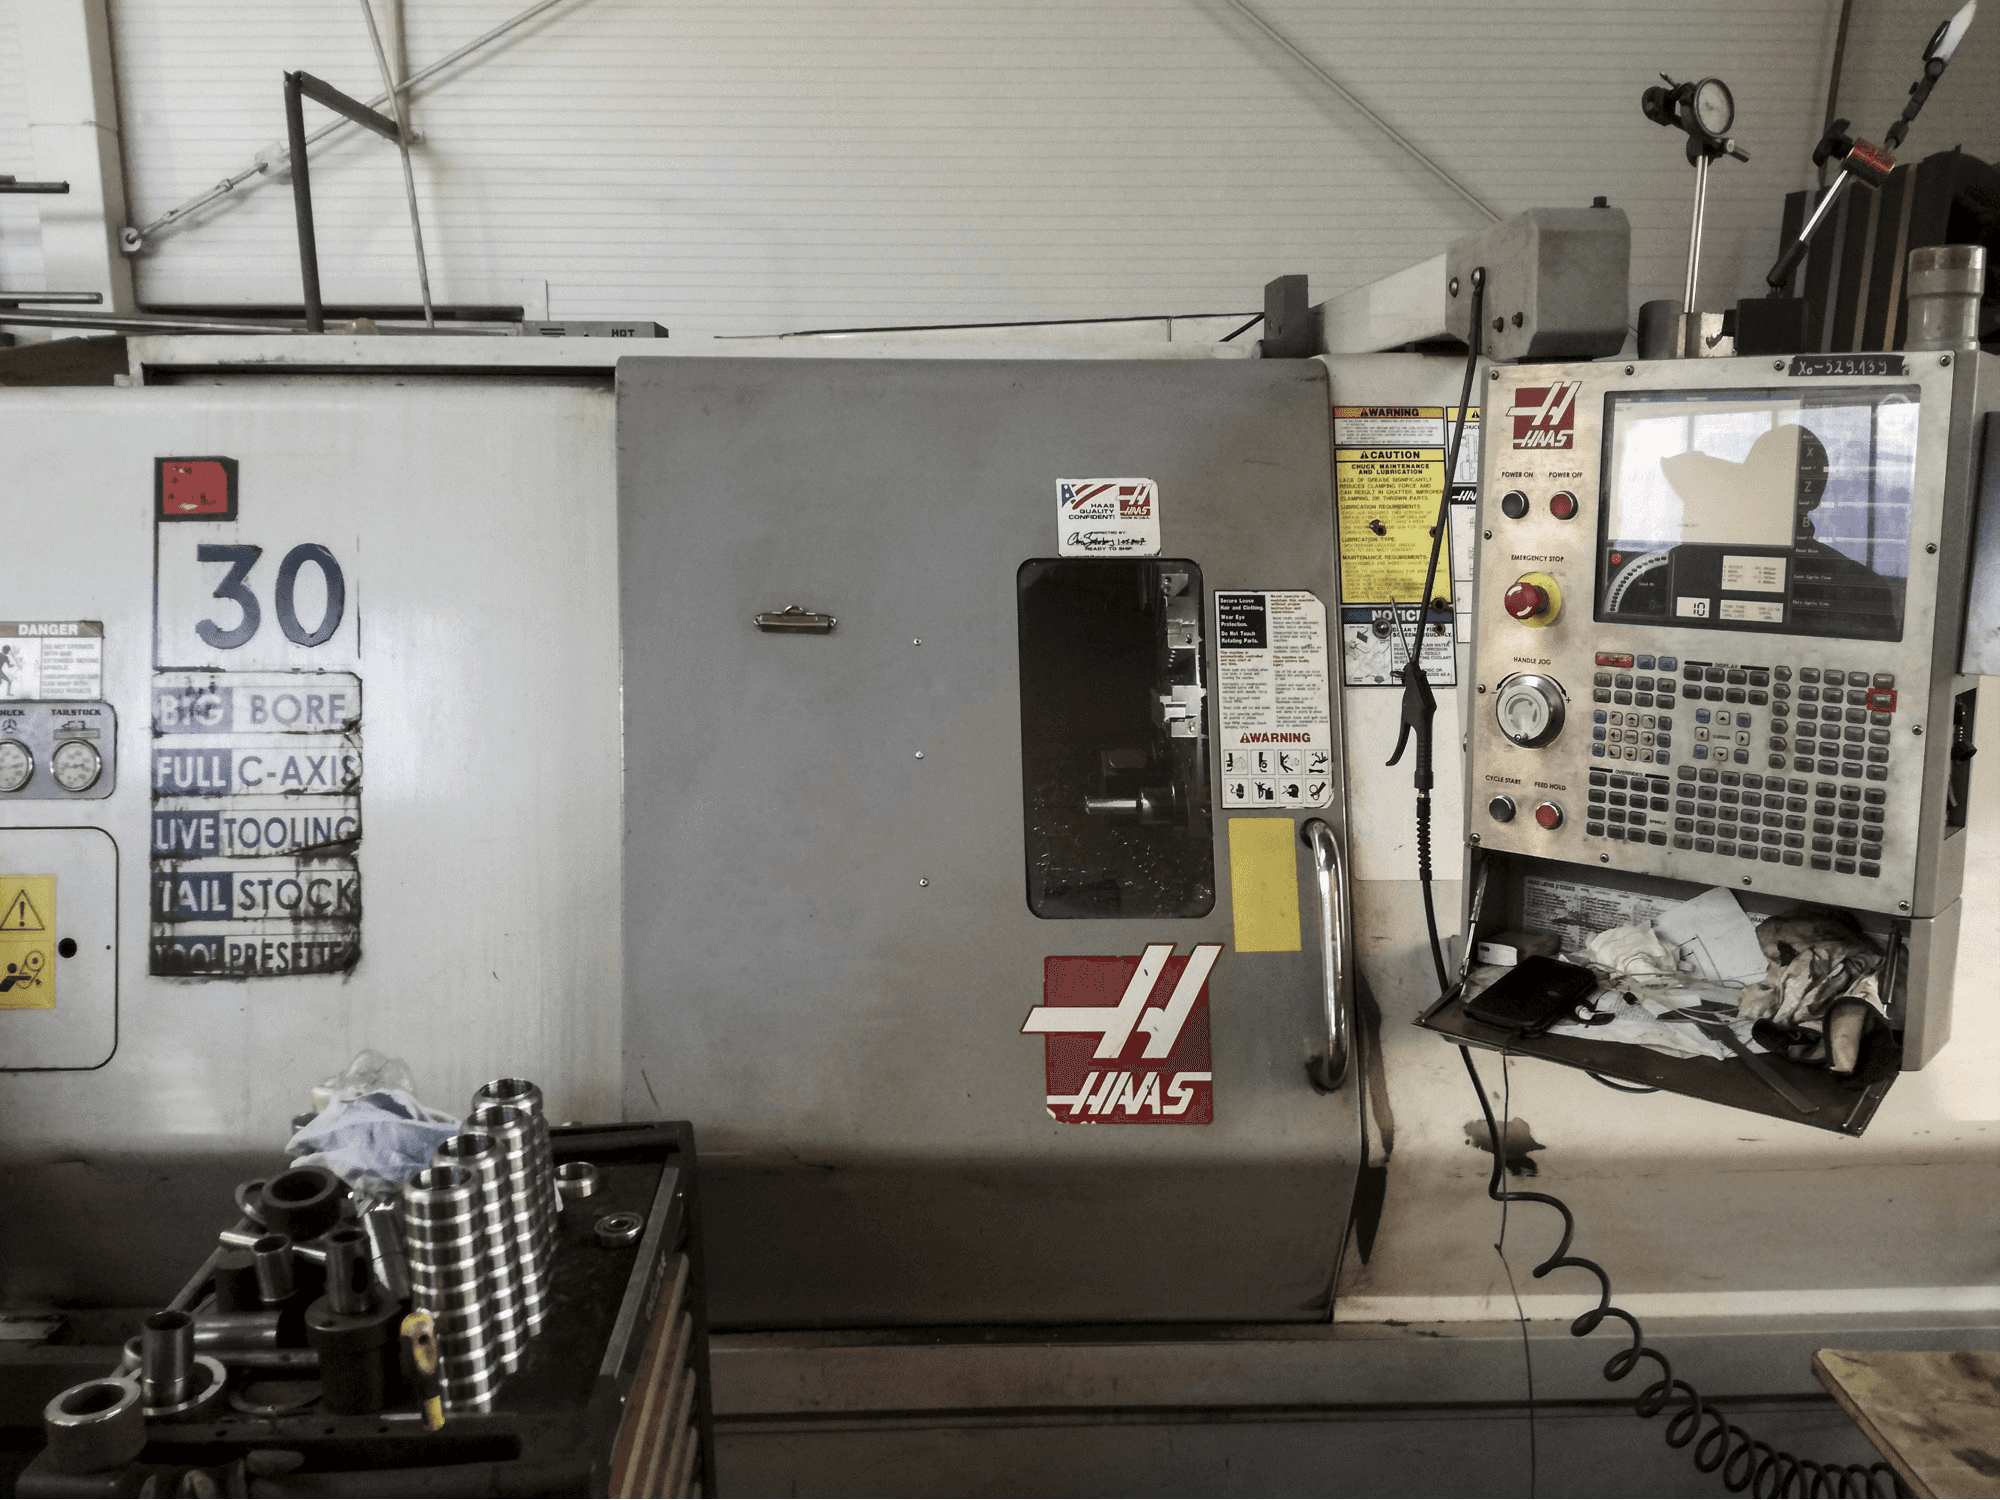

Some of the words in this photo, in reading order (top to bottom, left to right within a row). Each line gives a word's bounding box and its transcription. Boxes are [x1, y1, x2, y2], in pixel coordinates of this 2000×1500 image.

[1368, 408, 1420, 417] WARNING
[1512, 429, 1574, 448] HAAS
[1370, 451, 1420, 459] CAUTION
[1119, 506, 1151, 515] HAAS
[1511, 554, 1547, 562] EMERGENCY
[195, 542, 345, 649] 30
[1693, 602, 1706, 617] 10
[18, 623, 79, 636] DANGER
[1221, 637, 1242, 645] Rotating
[1513, 656, 1537, 664] HANDLE
[1538, 658, 1551, 666] JOG
[50, 708, 102, 716] TAILSTOCK
[160, 693, 225, 727] BIG
[250, 693, 347, 726] BORE
[1249, 732, 1311, 743] WARNING
[156, 755, 227, 787] FULL
[238, 754, 357, 787] C-AXIS
[1485, 774, 1504, 783] CYCLE
[1504, 777, 1521, 785] START
[1534, 781, 1549, 789] FEED
[1549, 783, 1567, 791] HOLD
[156, 817, 216, 850] LIVE
[158, 879, 227, 912] TAIL
[238, 877, 358, 911] STOCK
[1046, 1071, 1212, 1115] HAAS
